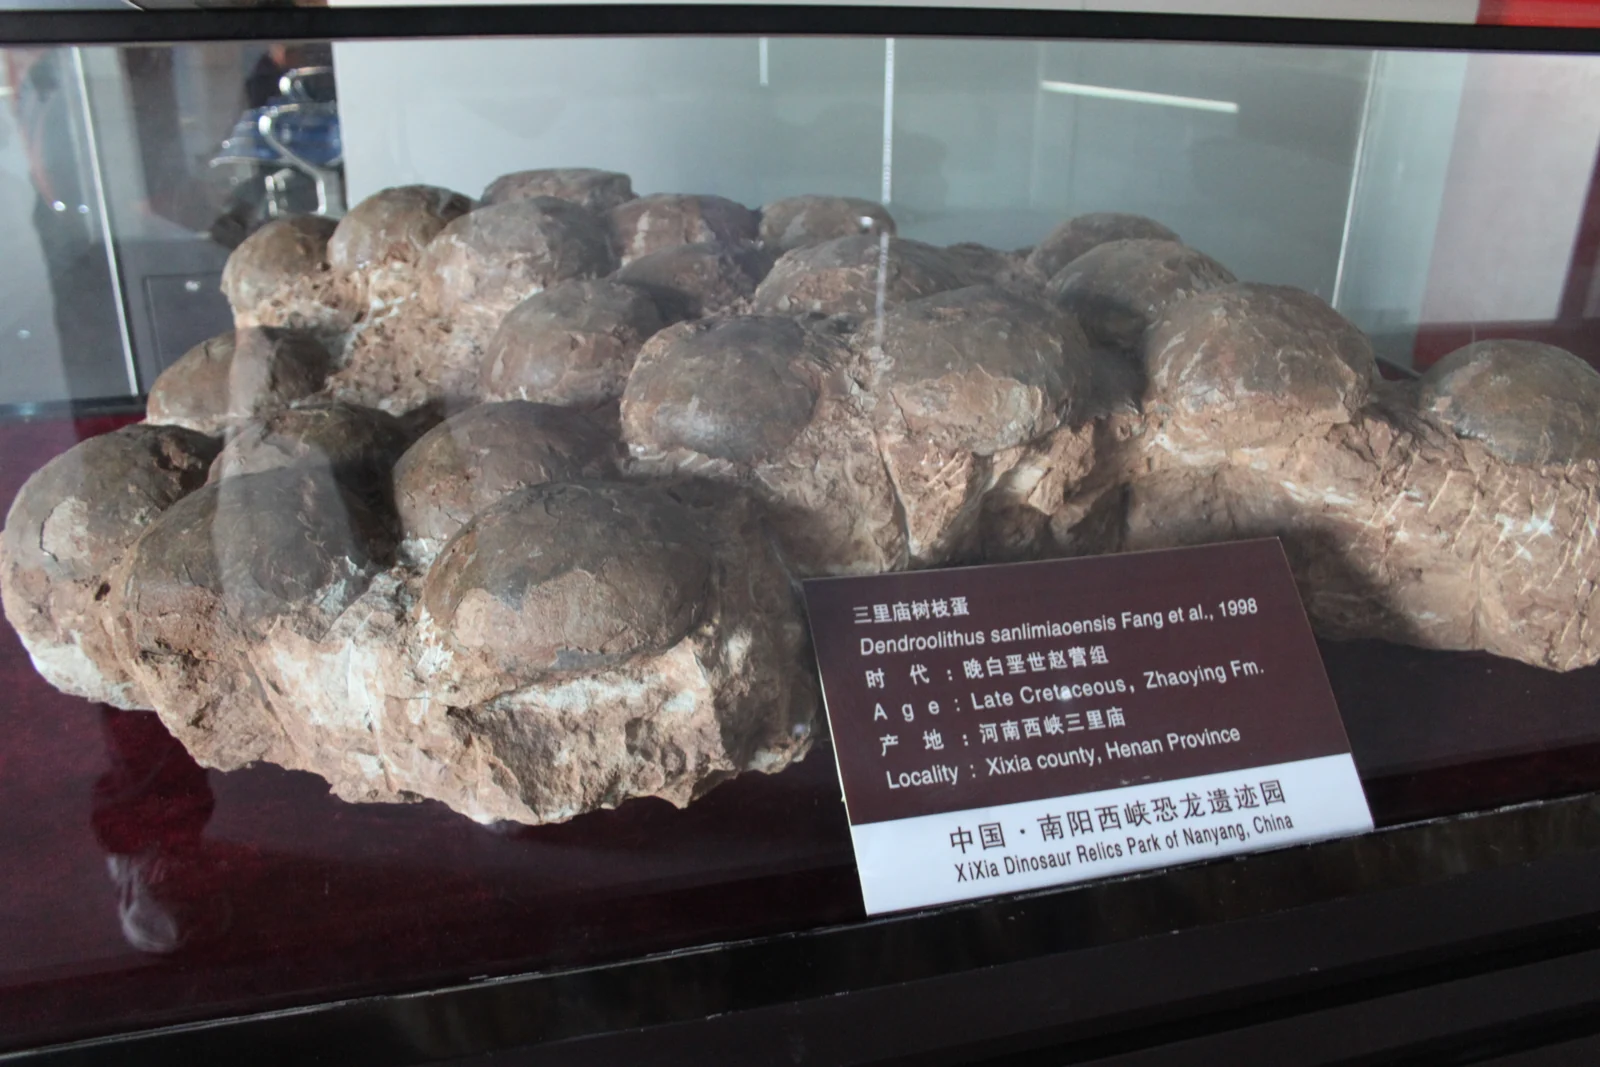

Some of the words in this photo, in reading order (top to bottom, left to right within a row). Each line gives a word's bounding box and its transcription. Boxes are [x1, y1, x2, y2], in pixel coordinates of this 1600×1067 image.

[853, 596, 970, 624] 三里庙树枝蛋
[860, 629, 985, 656] Dendroolithus
[990, 613, 1117, 643] sanlimiaoensis
[1121, 611, 1164, 630] Fang
[1168, 607, 1184, 623] et
[1189, 603, 1214, 621] al.,
[1218, 597, 1258, 617] 1998
[970, 691, 1014, 710] Late
[1019, 677, 1135, 704] Cretaceous,
[1143, 665, 1227, 689] Zhaoying
[1230, 660, 1264, 677] Fm.
[979, 706, 1126, 744] 河南西峡三里庙
[886, 765, 959, 789] Locality
[985, 754, 1032, 776] Xixia
[1036, 746, 1102, 769] county,
[1105, 739, 1164, 760] Henan
[1166, 727, 1241, 751] Province
[954, 860, 1000, 883] XiXia
[1004, 851, 1072, 875] Dinosaur
[1076, 842, 1123, 863] Relics
[1126, 833, 1162, 855] Park
[1165, 829, 1179, 849] of
[1183, 822, 1250, 846] Nanyang,
[1253, 814, 1294, 834] China
